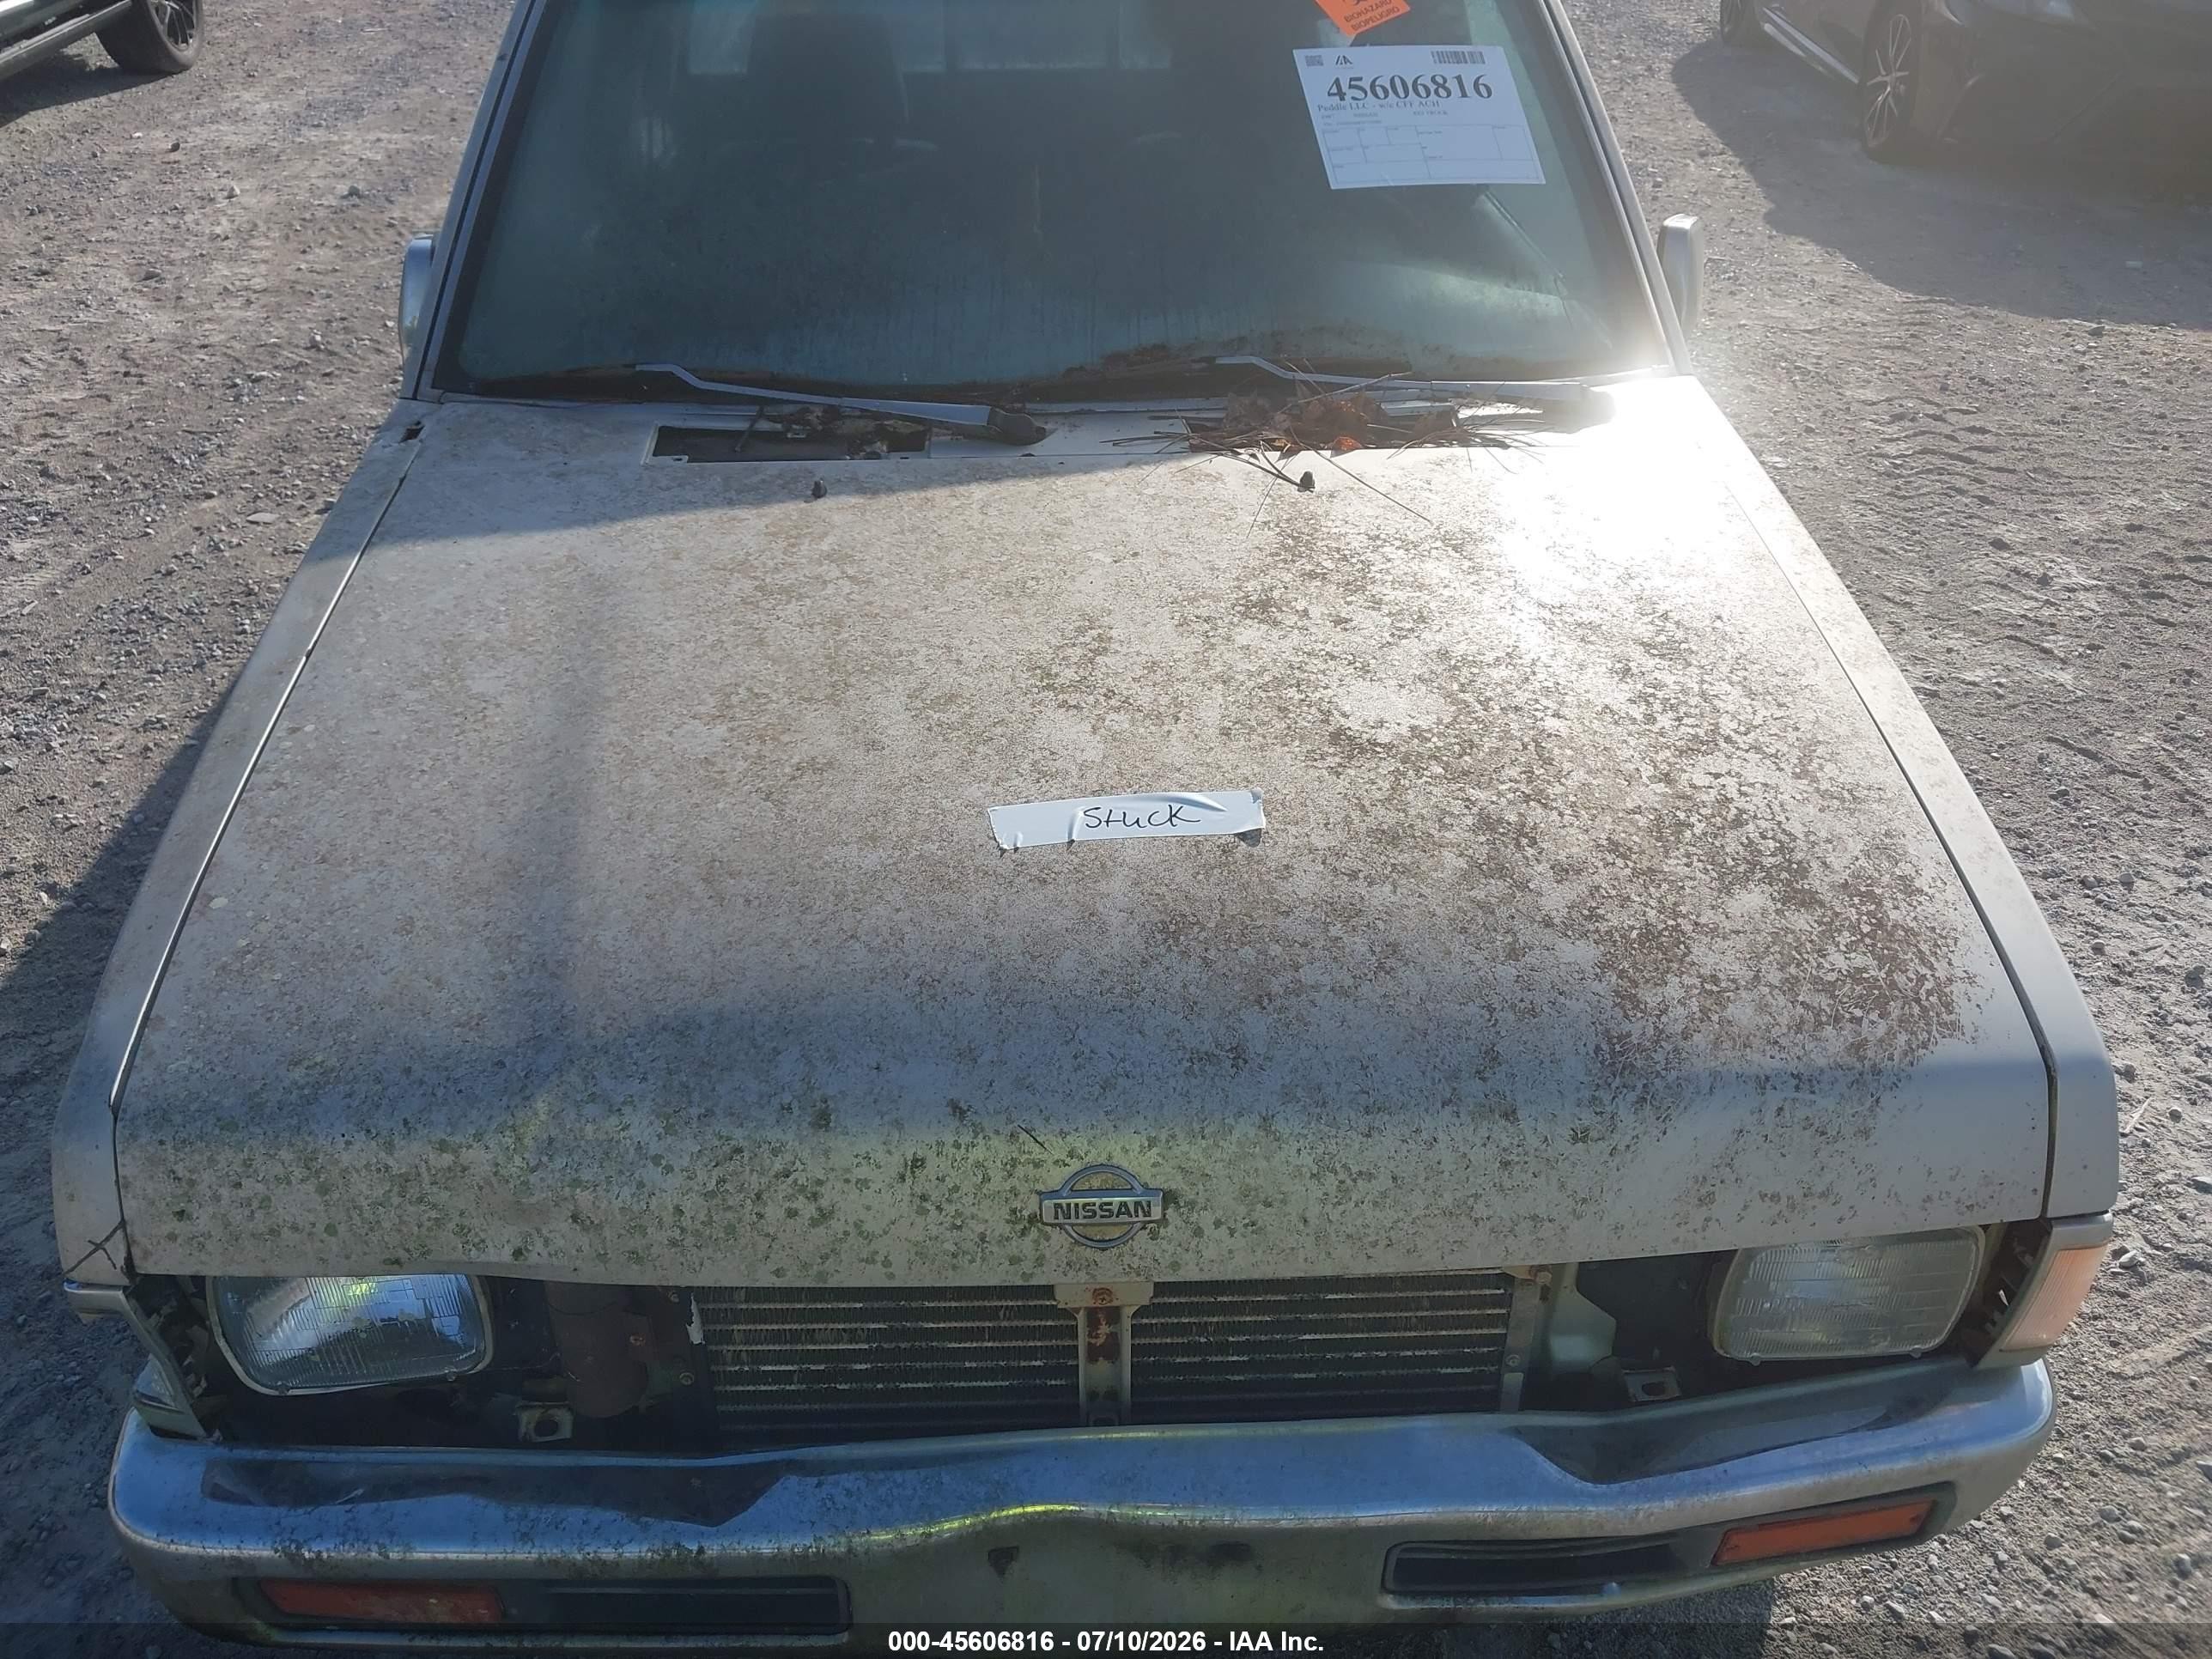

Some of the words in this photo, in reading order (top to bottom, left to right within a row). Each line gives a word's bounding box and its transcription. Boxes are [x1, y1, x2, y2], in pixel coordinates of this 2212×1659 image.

[1343, 0, 1392, 22] BIOHAZARD
[1351, 6, 1401, 31] BIOPELIGRO
[1327, 74, 1493, 102] 45606816
[1054, 1201, 1152, 1220] NISSAN
